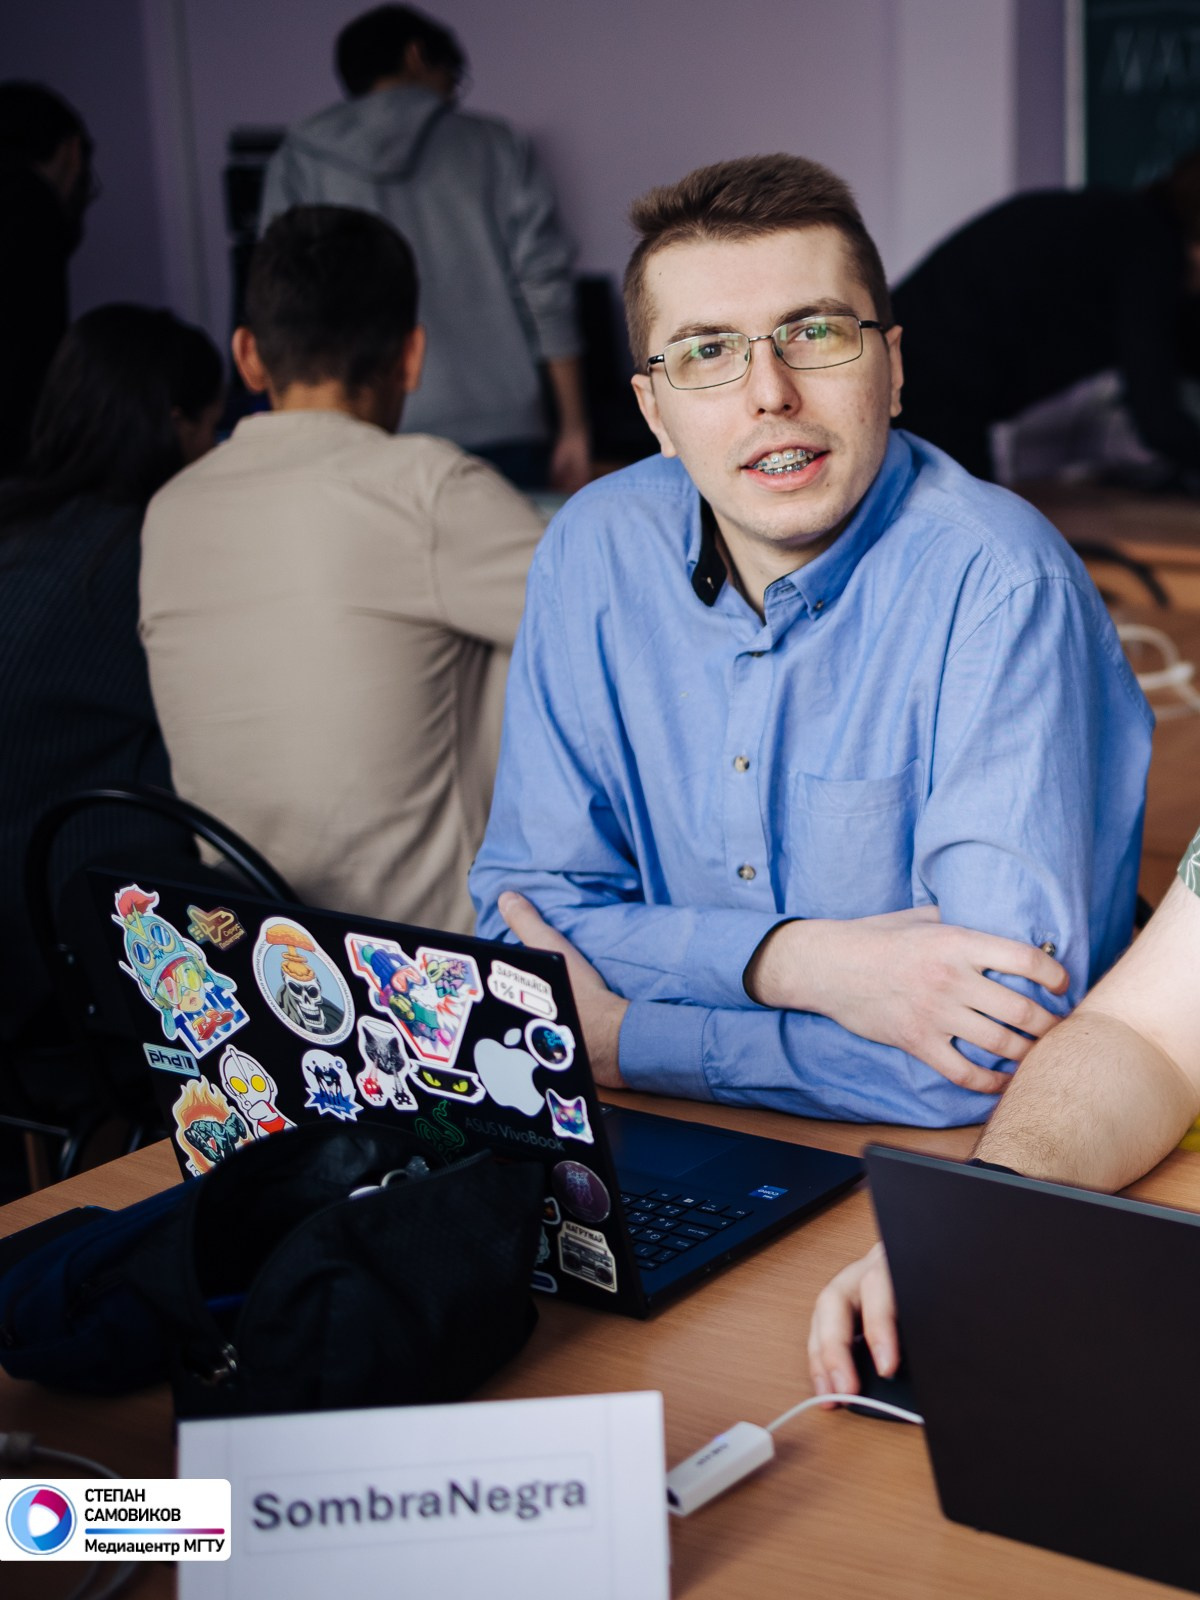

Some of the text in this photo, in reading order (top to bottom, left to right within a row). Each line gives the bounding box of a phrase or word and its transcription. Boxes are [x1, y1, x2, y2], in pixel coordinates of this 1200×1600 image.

[465, 1117, 565, 1152] ASUS VivoBook
[252, 1478, 586, 1531] SombraNegra
